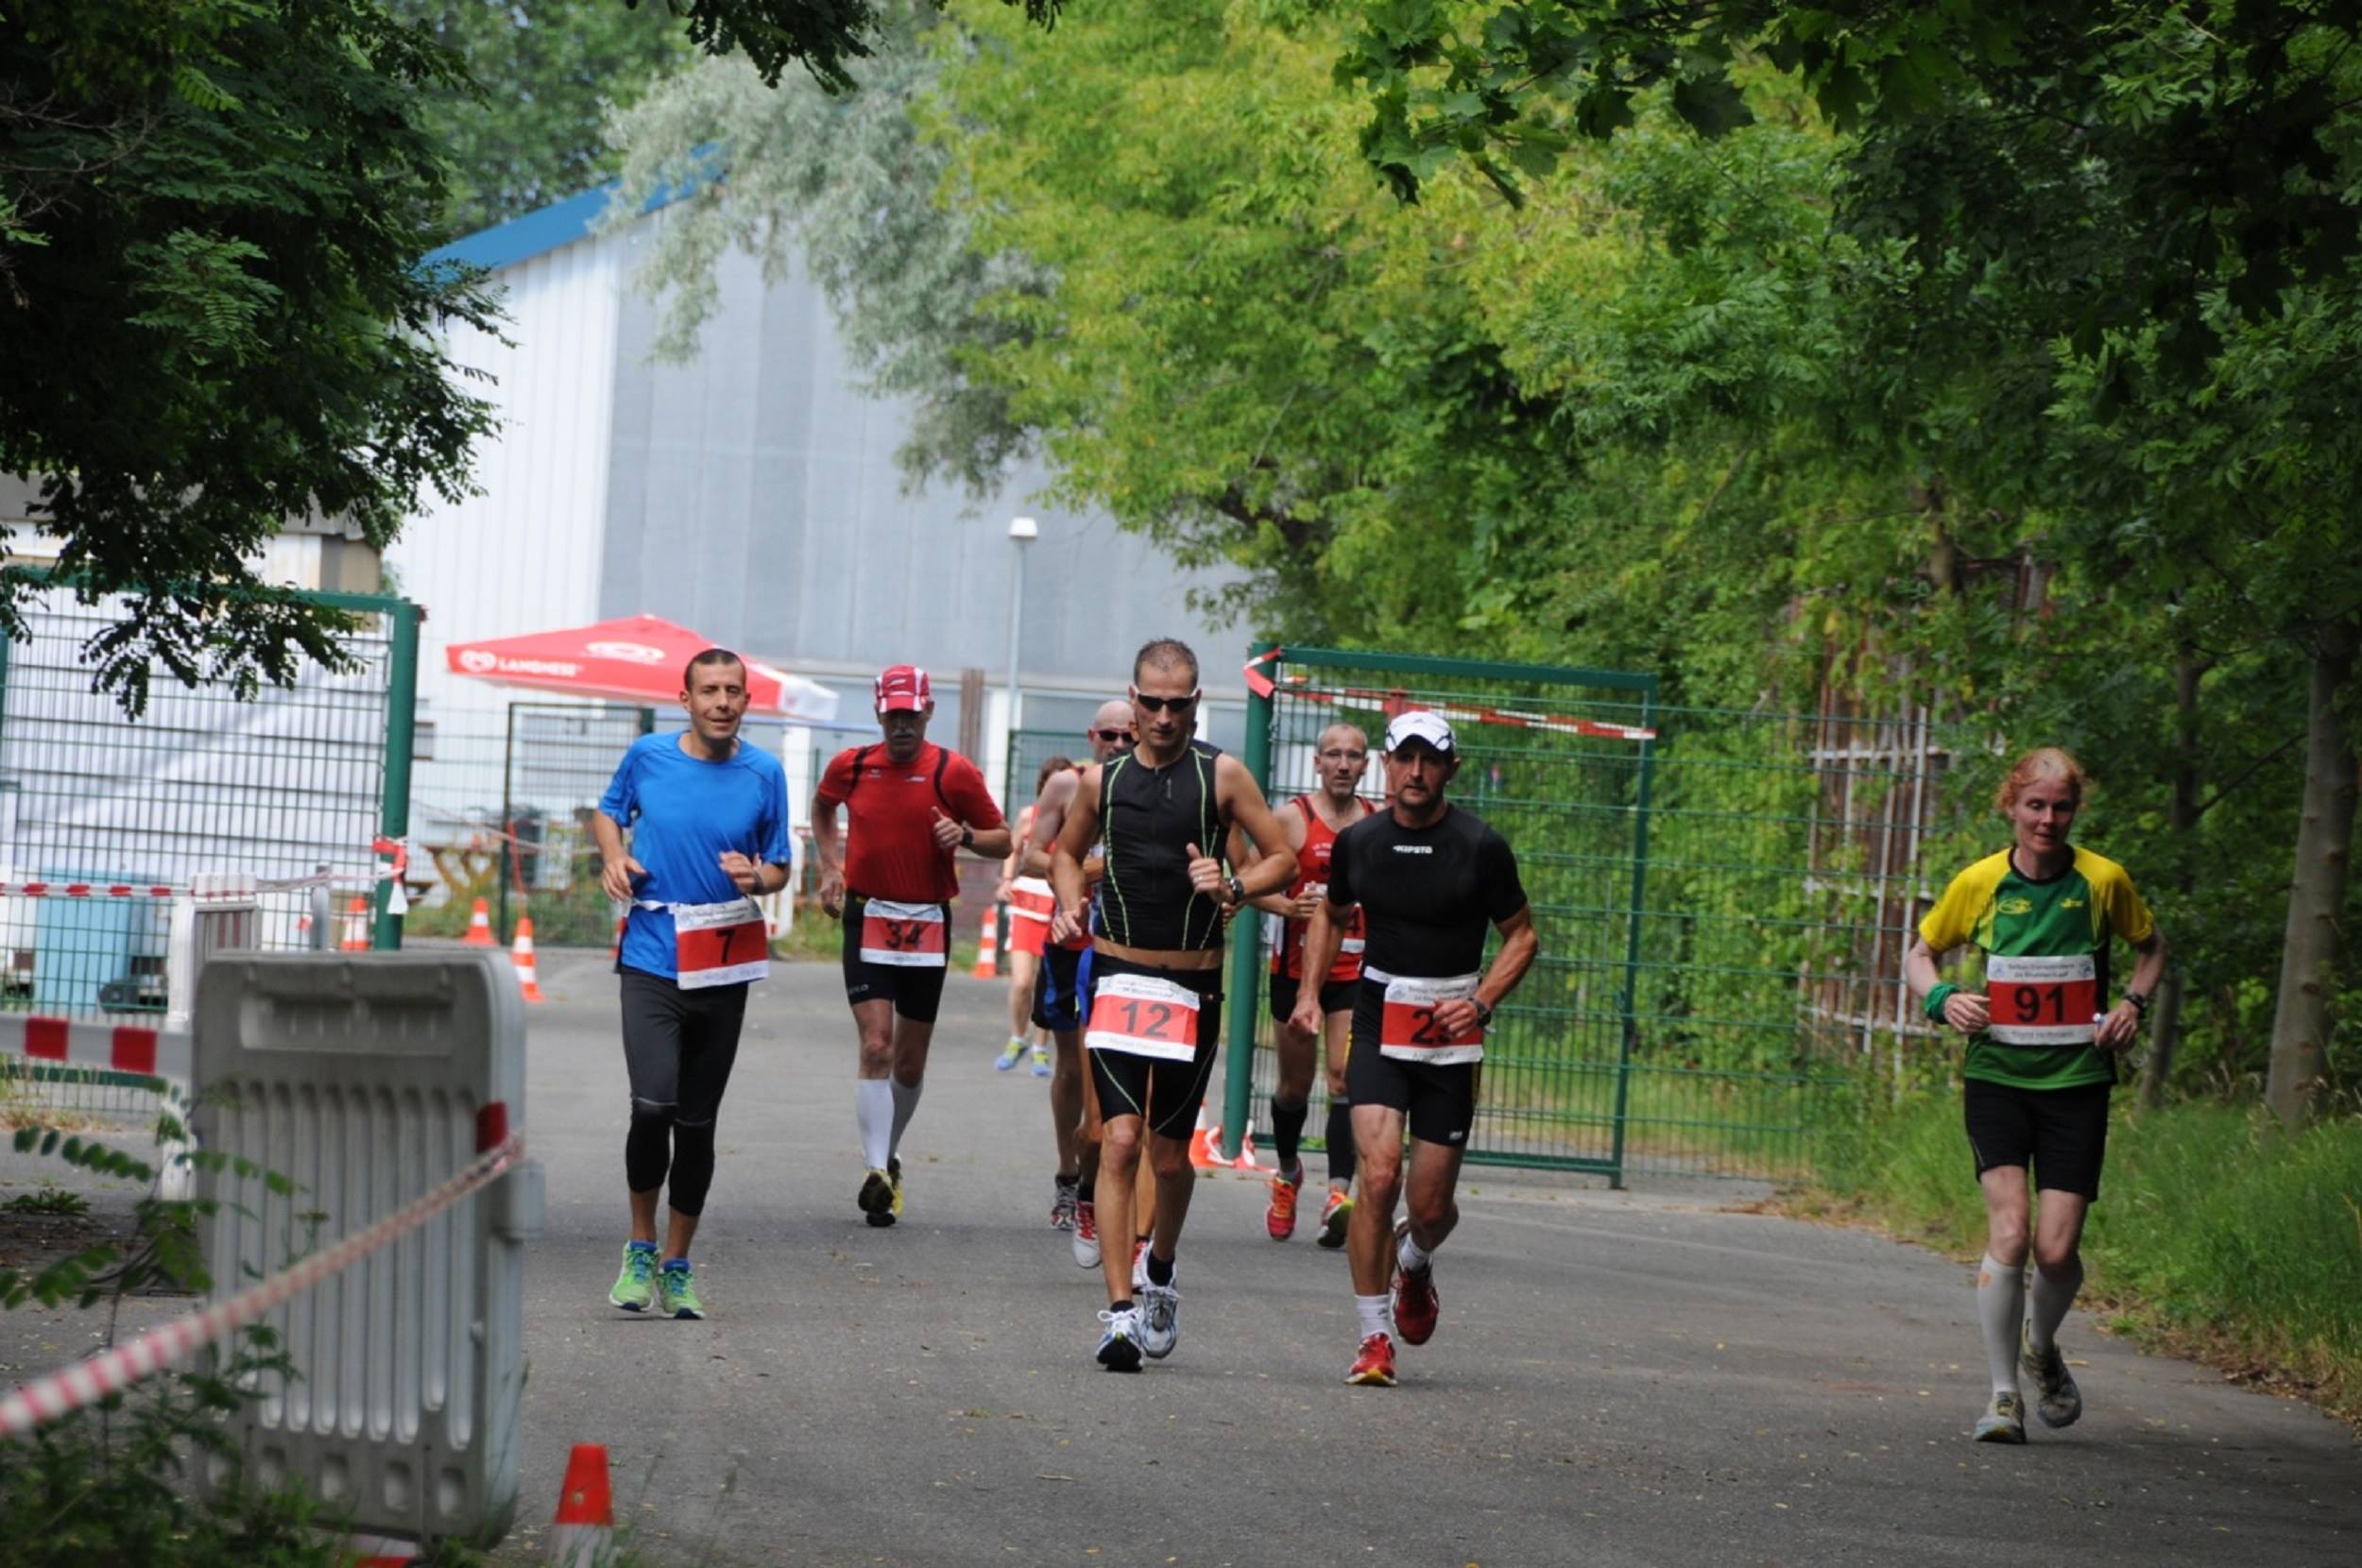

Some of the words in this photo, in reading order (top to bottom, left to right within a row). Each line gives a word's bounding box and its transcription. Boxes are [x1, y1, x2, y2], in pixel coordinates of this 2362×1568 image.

[715, 929, 736, 964] 7
[885, 920, 922, 950] 34
[1121, 999, 1171, 1038] 12
[2014, 984, 2064, 1023] 91
